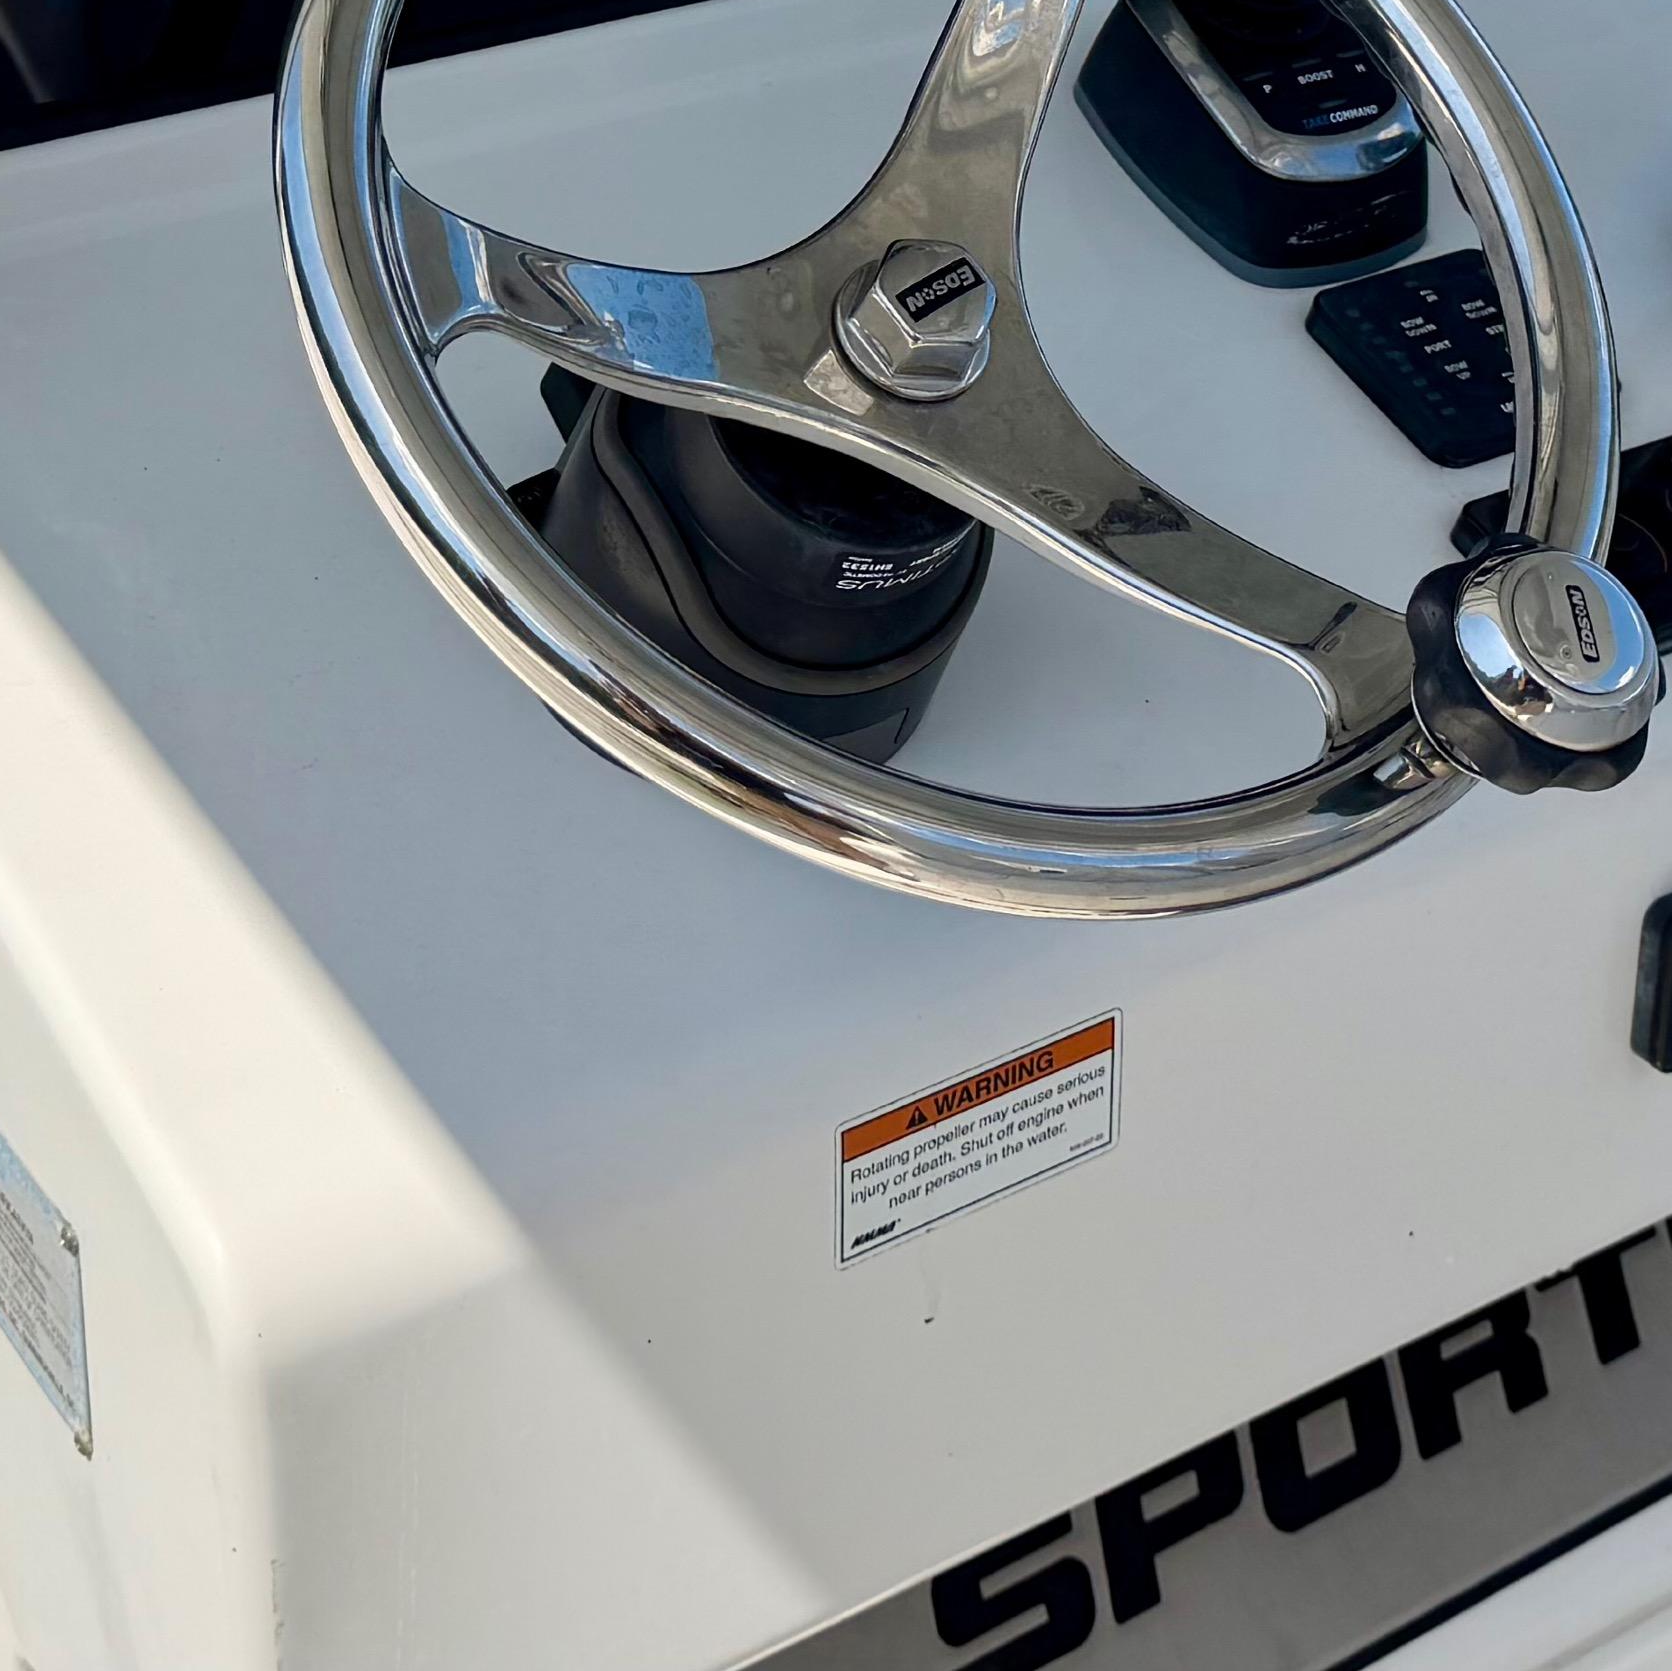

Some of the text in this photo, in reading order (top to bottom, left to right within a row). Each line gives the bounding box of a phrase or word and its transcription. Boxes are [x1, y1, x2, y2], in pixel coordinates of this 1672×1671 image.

[1262, 84, 1273, 94] P
[1297, 69, 1334, 85] BOOST
[1329, 104, 1379, 124] COMMAND
[906, 265, 976, 312] EDSON
[1570, 589, 1598, 658] EDSON
[934, 1050, 1054, 1116] WARNING
[850, 1065, 1105, 1184] Rotating propeller may cause serious
[851, 1085, 1104, 1205] injury or death. Shut off engine when
[889, 1185, 922, 1208] near
[925, 1159, 982, 1196] persons
[985, 1151, 998, 1166] in
[1001, 1140, 1024, 1159] the
[1027, 1121, 1068, 1147] water.
